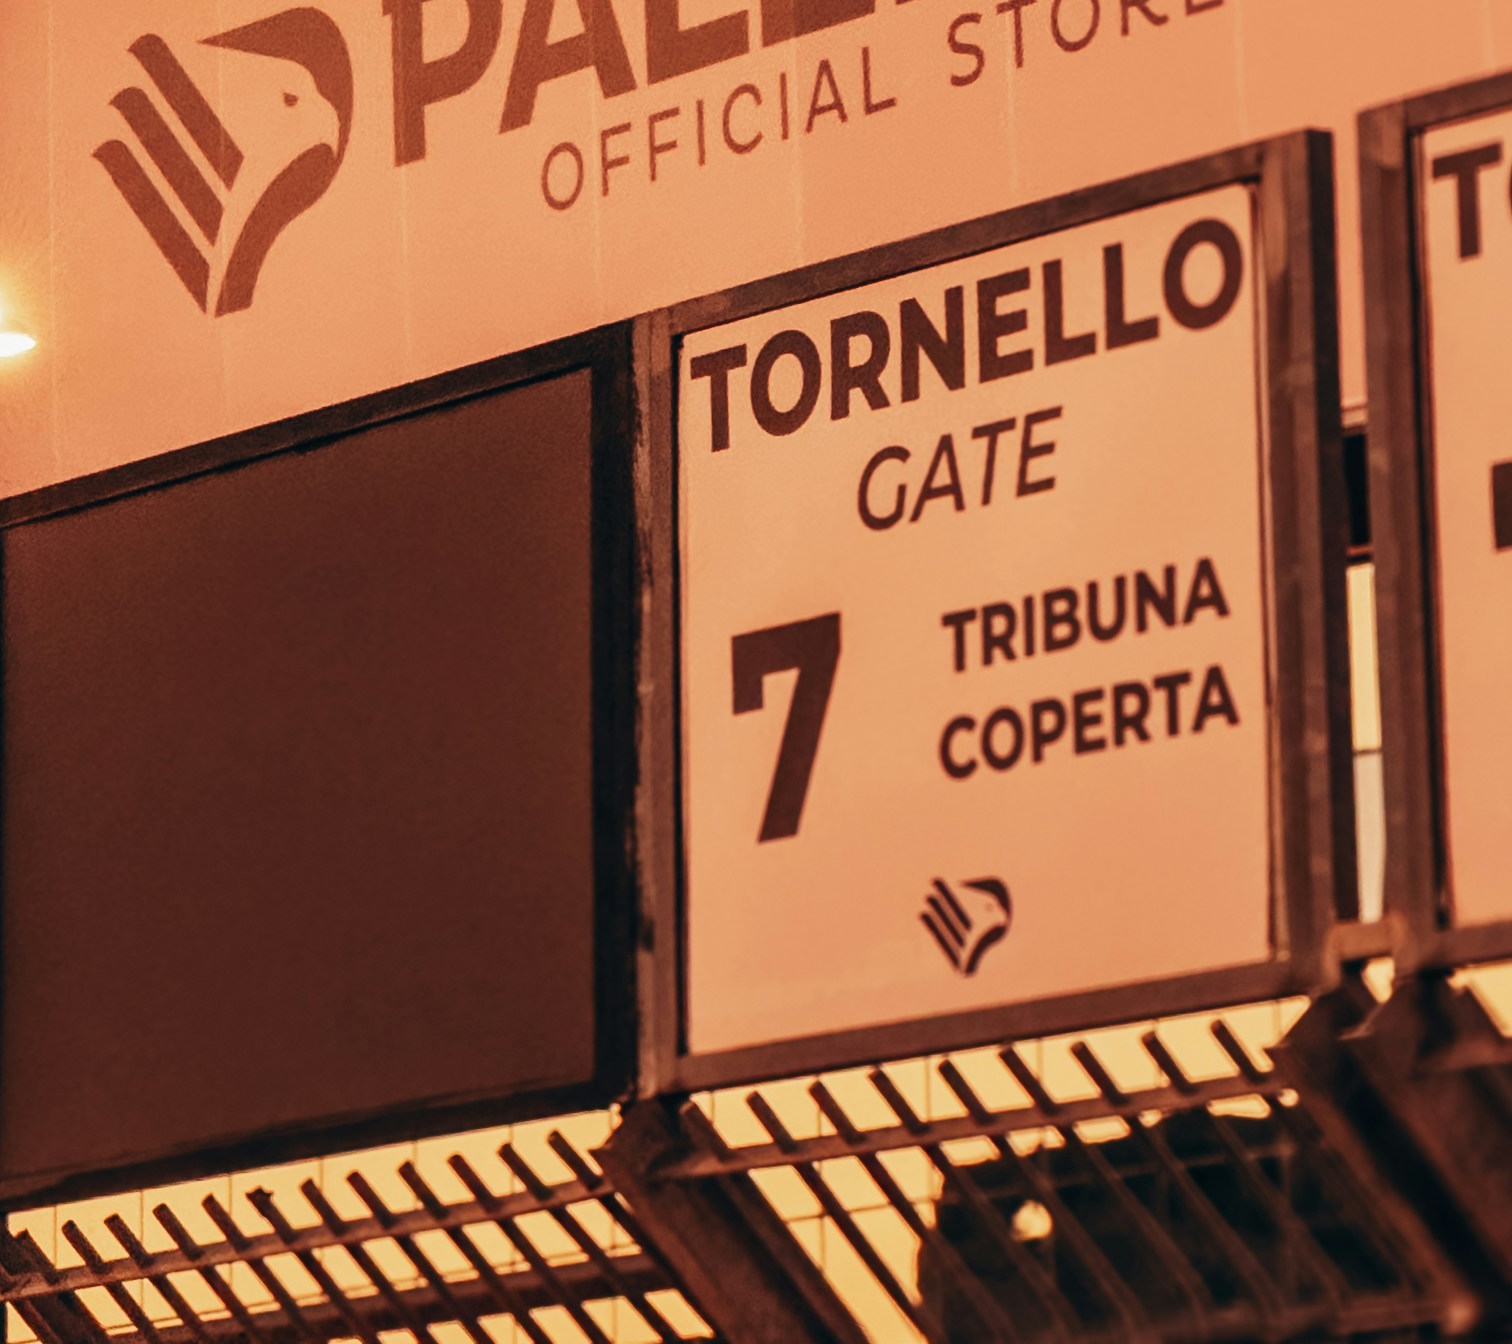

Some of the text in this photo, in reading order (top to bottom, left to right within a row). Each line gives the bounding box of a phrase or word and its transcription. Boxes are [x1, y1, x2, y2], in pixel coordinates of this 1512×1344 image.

[541, 46, 897, 212] OFFICIAL
[690, 218, 1243, 452] TORNELLO
[857, 406, 1063, 532] GATE
[942, 558, 1230, 672] TRIBUNA
[731, 612, 842, 843] 7
[939, 665, 1240, 779] COPERTA
